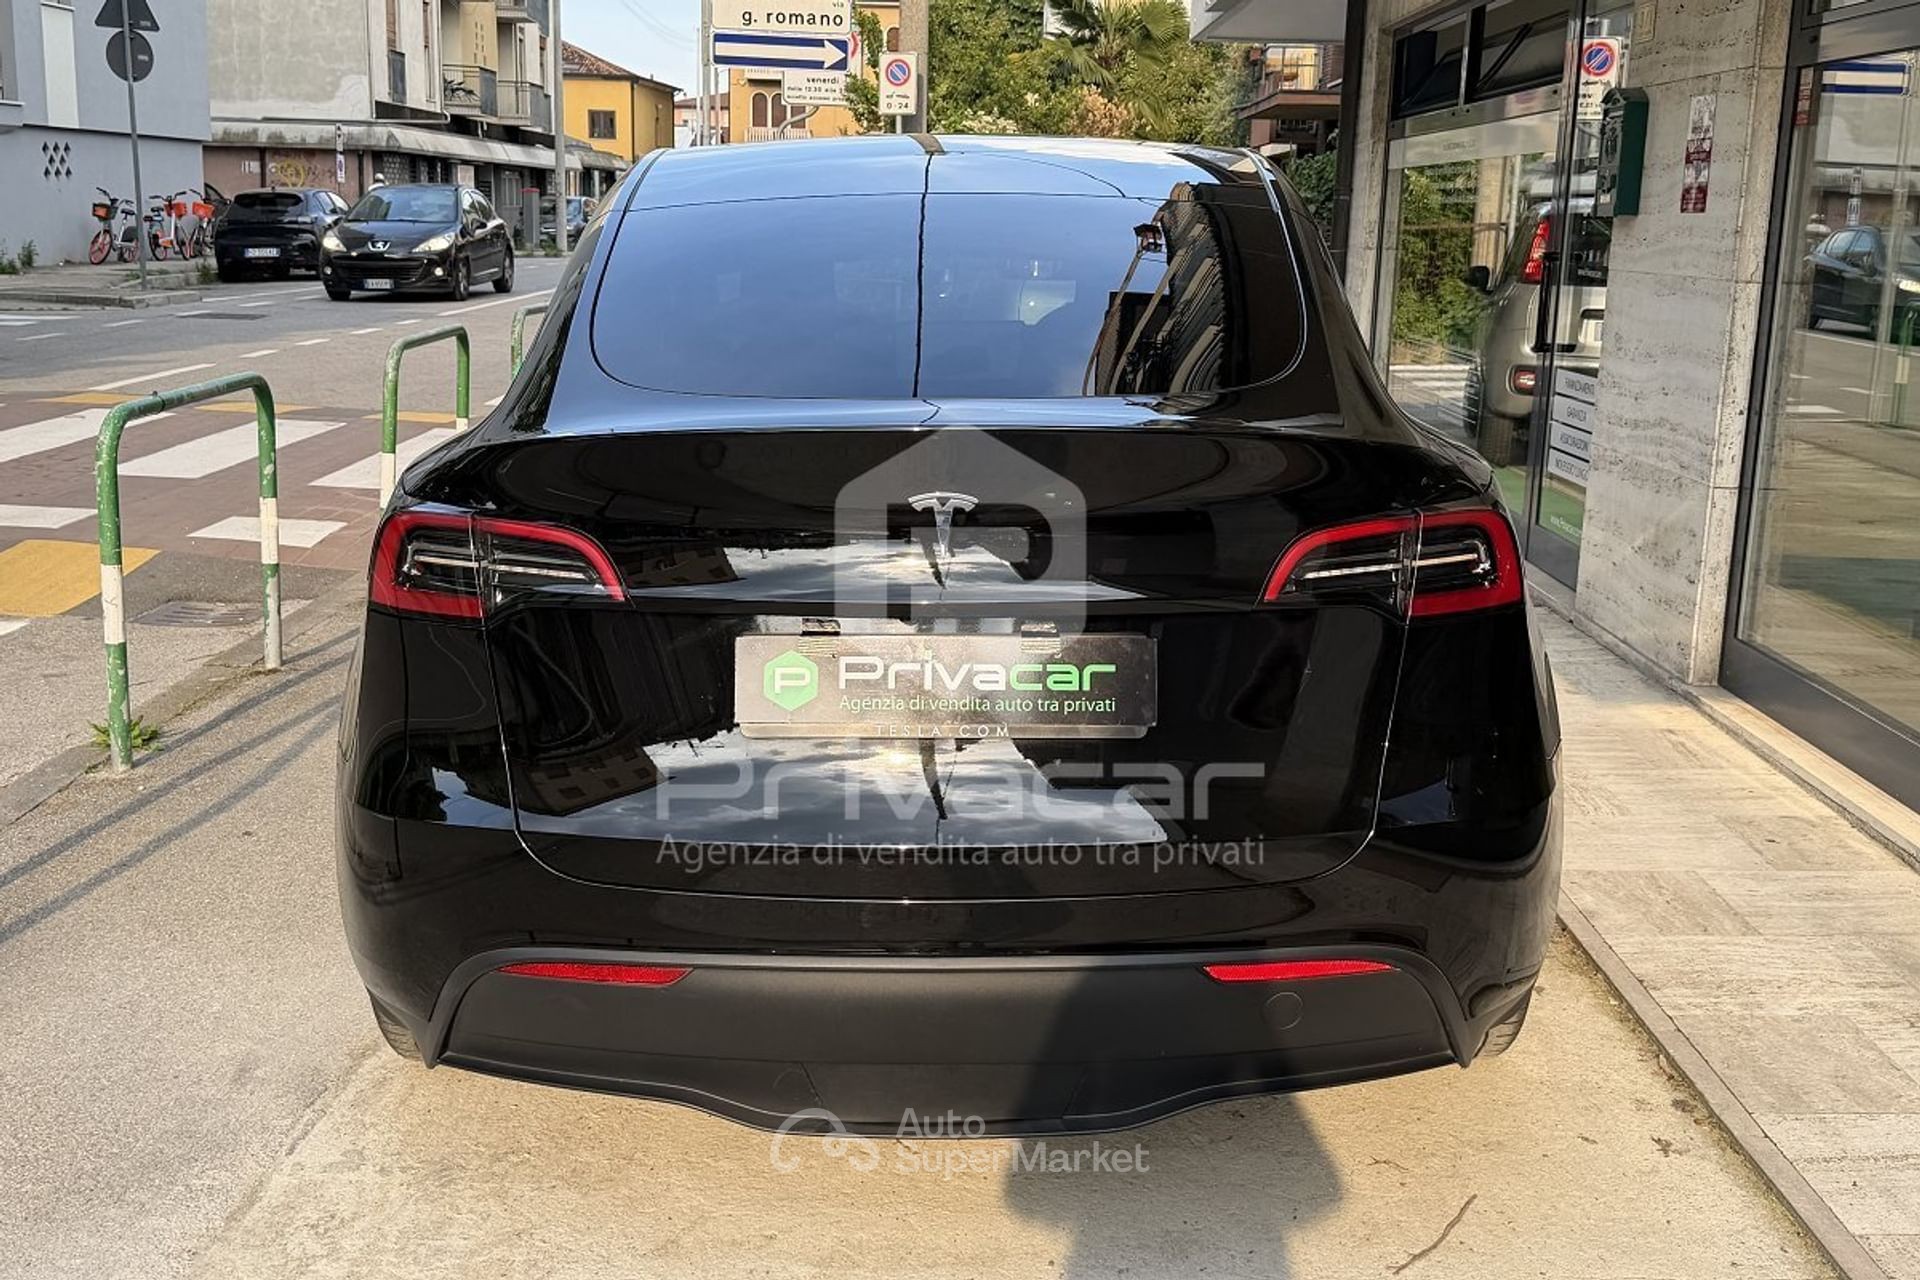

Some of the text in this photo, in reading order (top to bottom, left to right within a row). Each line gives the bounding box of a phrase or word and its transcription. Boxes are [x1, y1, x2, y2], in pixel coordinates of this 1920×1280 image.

[742, 11, 843, 27] g. romano
[838, 654, 1117, 691] Privacar
[838, 694, 1116, 715] Agenzia di vendita auto tra privati
